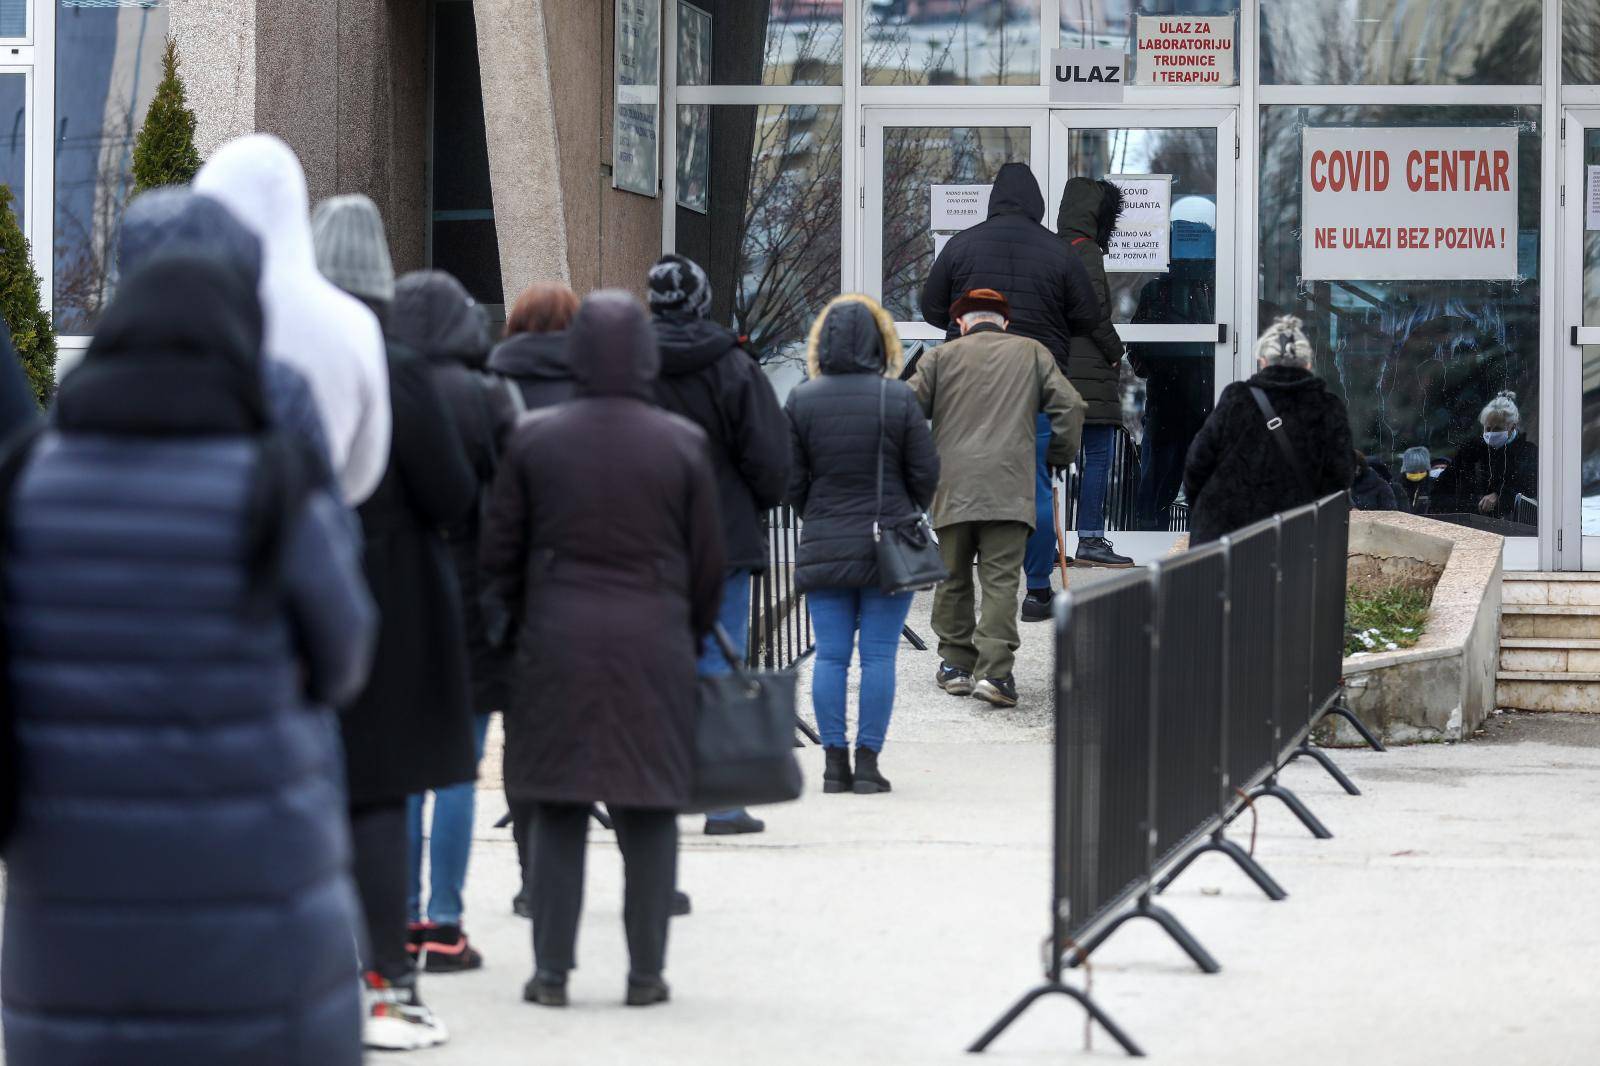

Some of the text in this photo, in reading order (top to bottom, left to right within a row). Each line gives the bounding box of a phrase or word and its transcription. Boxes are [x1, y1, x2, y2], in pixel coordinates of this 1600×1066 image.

[1159, 22, 1211, 34] ULAZ ZA
[1138, 38, 1231, 50] LABORATORIJU
[1153, 55, 1216, 66] TRUDNICE
[1055, 65, 1120, 83] ULAZ
[1152, 71, 1220, 82] I TERAPIJU
[1310, 149, 1510, 192] COVID CENTAR
[1314, 227, 1505, 249] NE ULAZI BEZ POZIVA !
